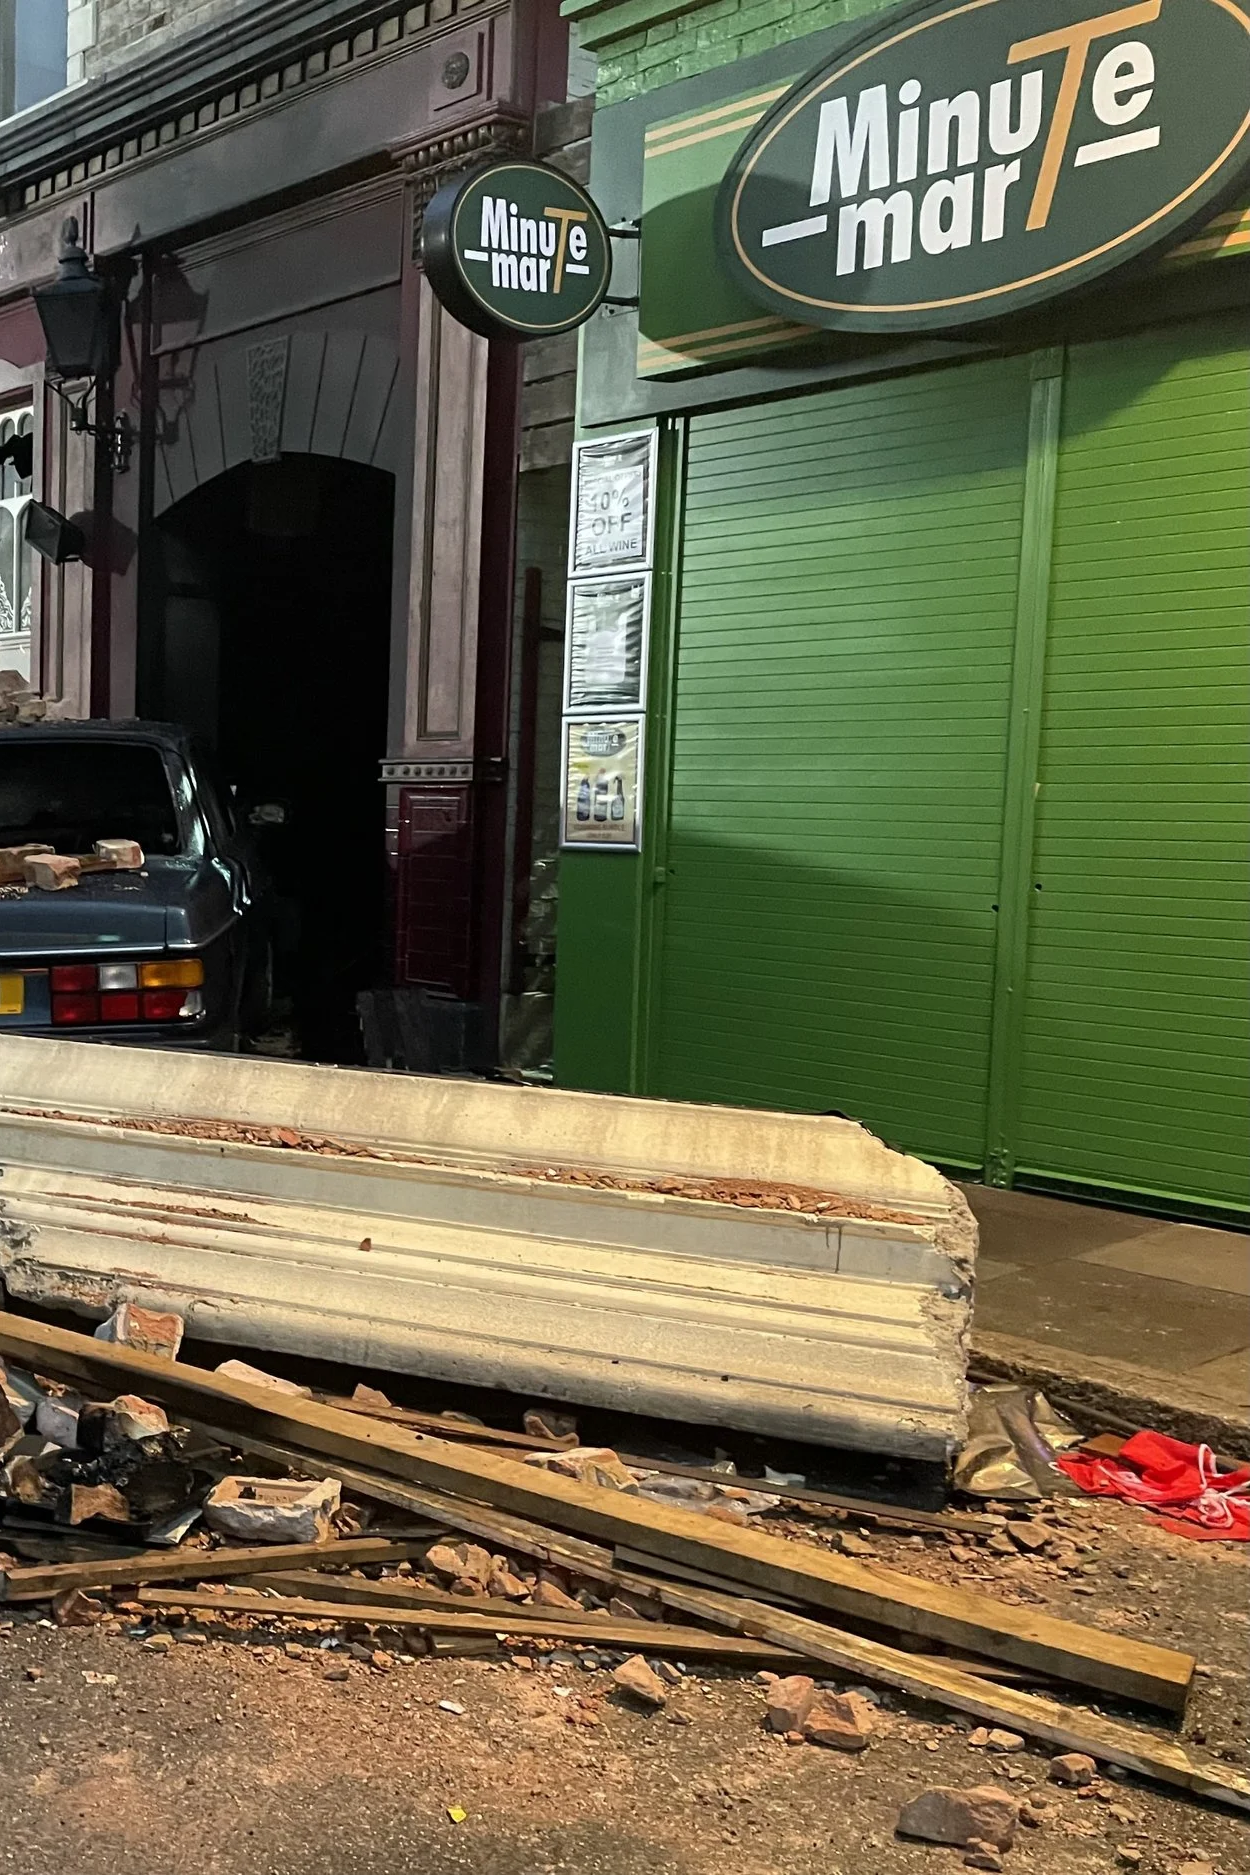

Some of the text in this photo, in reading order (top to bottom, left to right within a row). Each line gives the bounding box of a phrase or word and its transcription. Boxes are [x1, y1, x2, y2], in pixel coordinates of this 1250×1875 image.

[590, 487, 630, 513] 10%
[591, 512, 632, 536] OFF
[585, 538, 638, 555] ALL WINE
